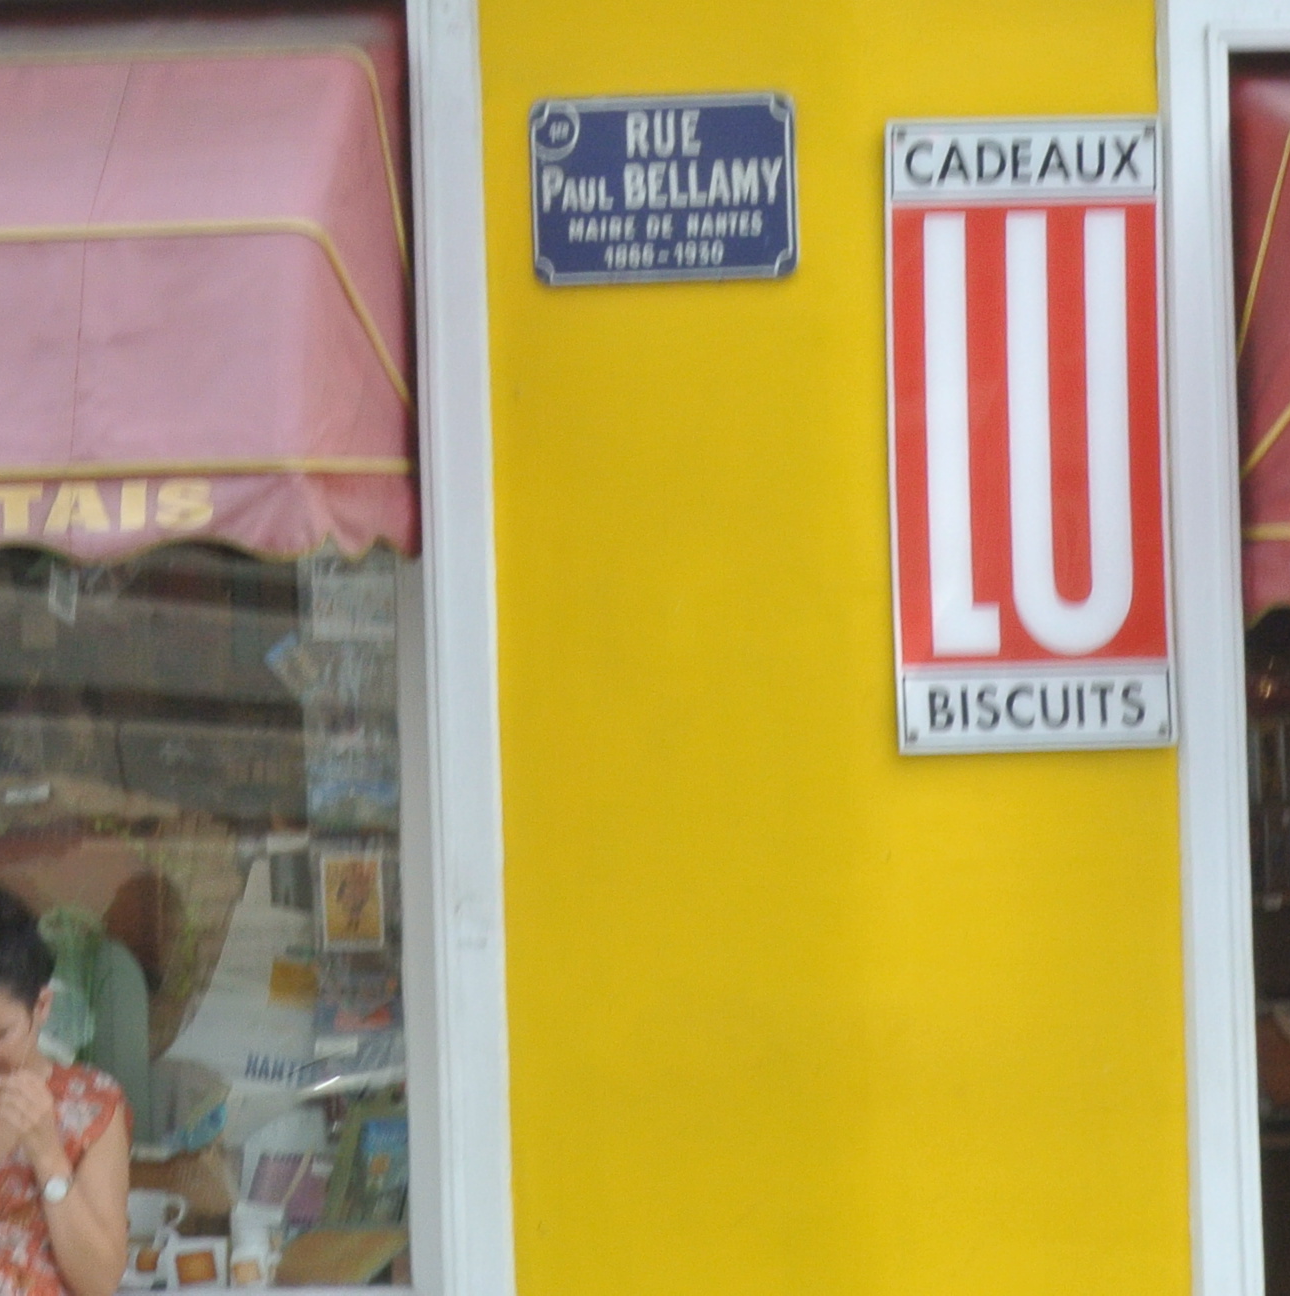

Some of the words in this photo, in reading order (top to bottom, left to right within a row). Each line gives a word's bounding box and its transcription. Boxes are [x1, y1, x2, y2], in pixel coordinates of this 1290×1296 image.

[624, 109, 703, 159] RUE
[622, 157, 783, 211] BELLAMY
[904, 135, 1143, 188] CADEAUX
[567, 216, 636, 243] MAIRE
[646, 214, 673, 240] DE
[686, 210, 764, 238] NANTES
[922, 208, 1134, 657] LU
[926, 682, 1147, 736] BISCUITS
